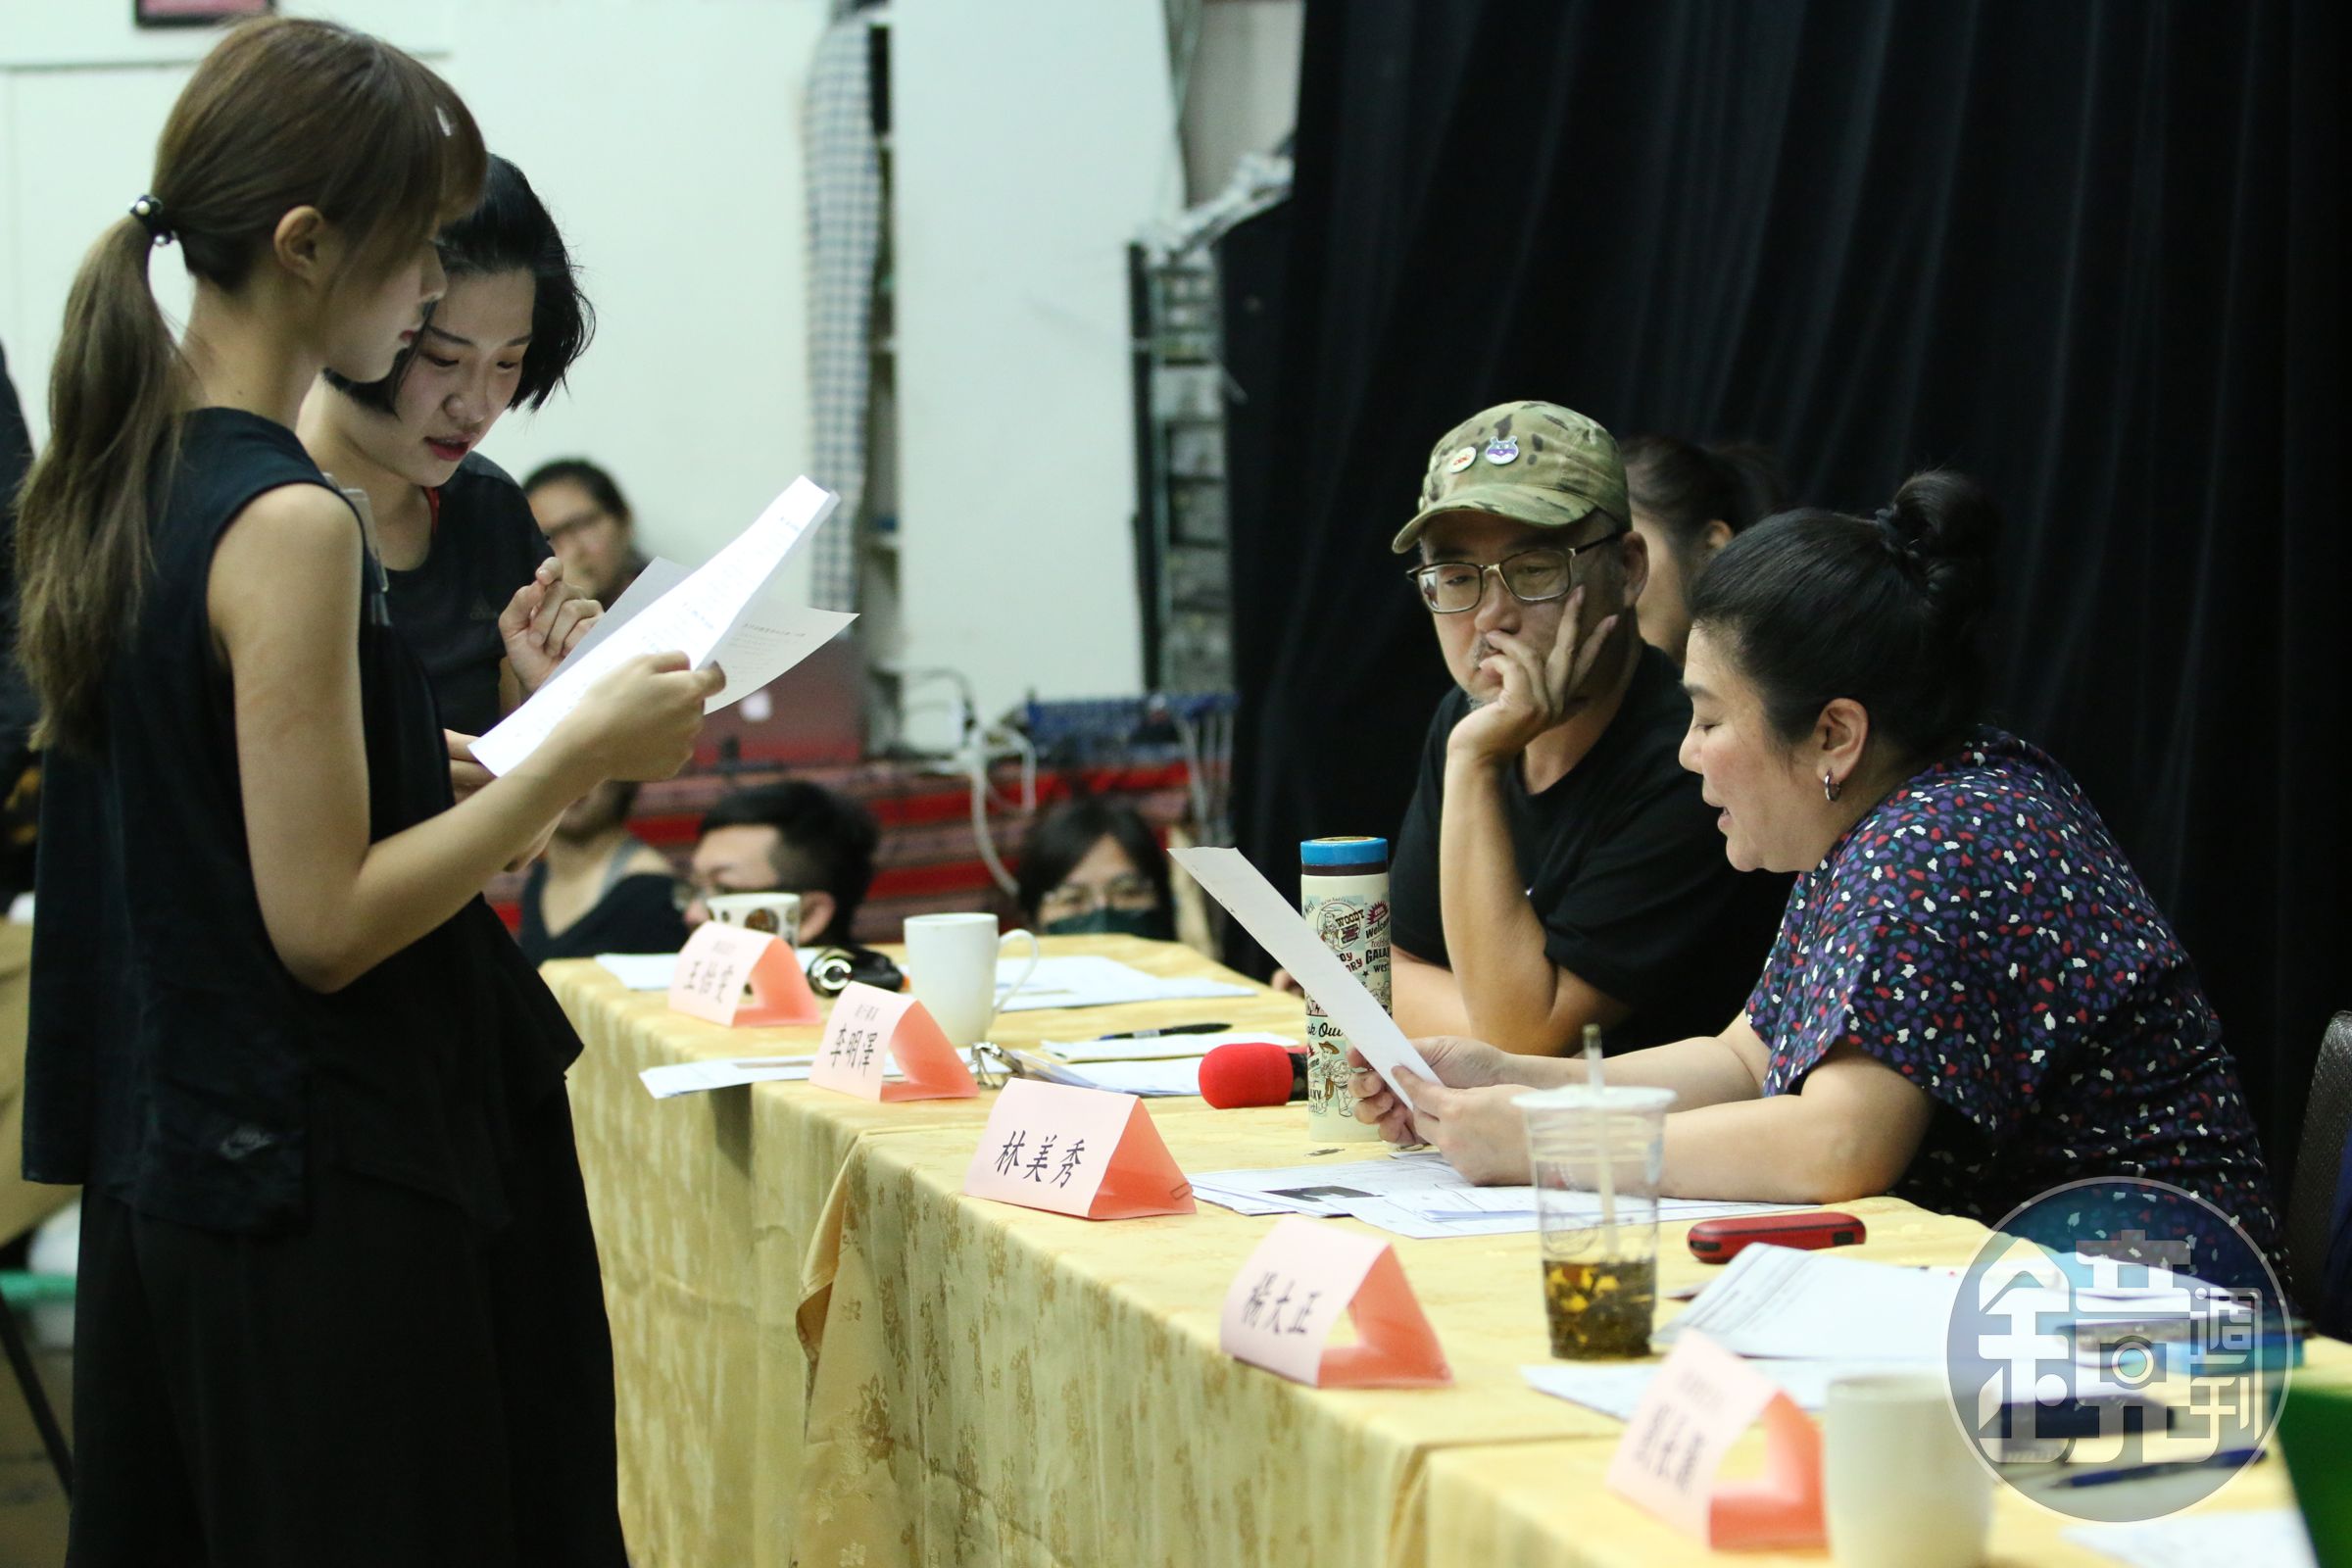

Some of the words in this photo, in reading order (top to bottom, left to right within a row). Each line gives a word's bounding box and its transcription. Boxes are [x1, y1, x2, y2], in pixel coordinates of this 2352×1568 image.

[1336, 909, 1365, 927] WOODY
[830, 1022, 878, 1077] 李明澤
[995, 1130, 1085, 1189] 林美秀
[1241, 1272, 1323, 1335] 楊大正
